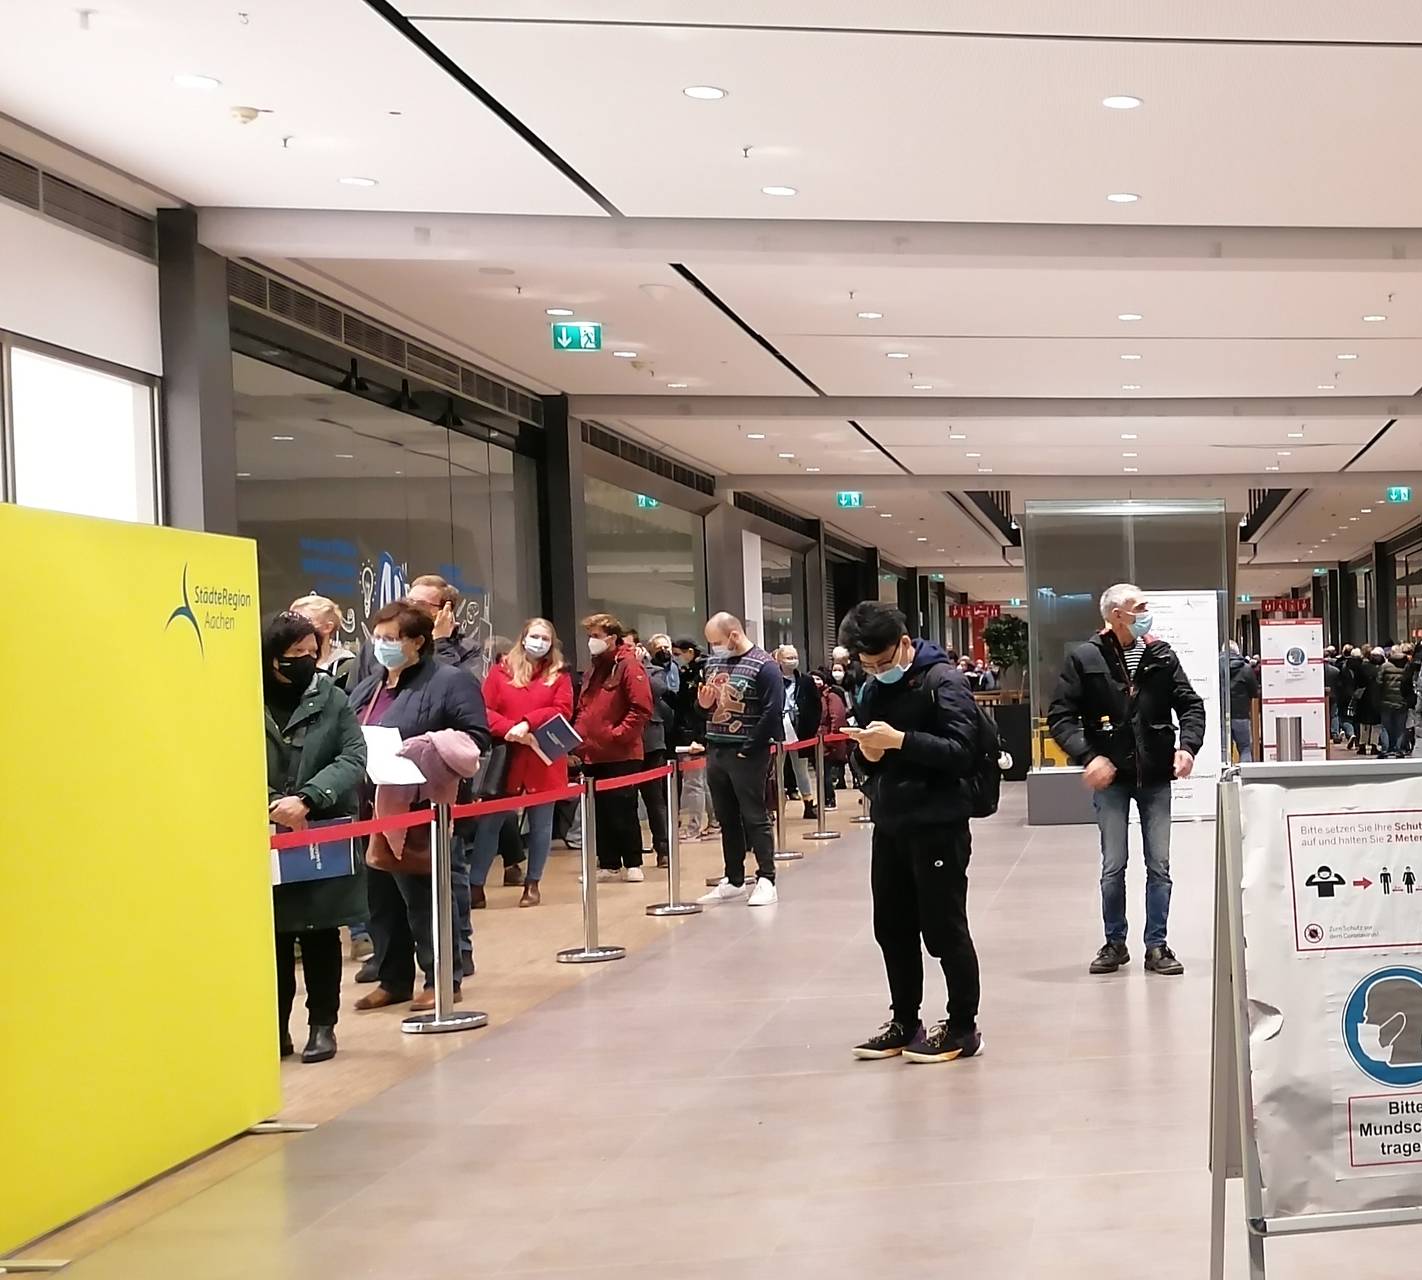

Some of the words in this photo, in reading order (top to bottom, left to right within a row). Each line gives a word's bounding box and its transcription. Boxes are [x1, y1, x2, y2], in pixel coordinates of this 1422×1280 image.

[194, 585, 251, 611] StädteRegion
[204, 611, 235, 630] Aachen
[1300, 825, 1323, 835] Bitte
[1325, 825, 1356, 834] setzen
[1358, 823, 1372, 833] Sie
[1374, 823, 1393, 832] Ihre
[1301, 837, 1316, 847] auf
[1318, 837, 1337, 846] und
[1338, 836, 1368, 845] halten
[1369, 834, 1384, 844] Sie
[1386, 834, 1393, 843] 2
